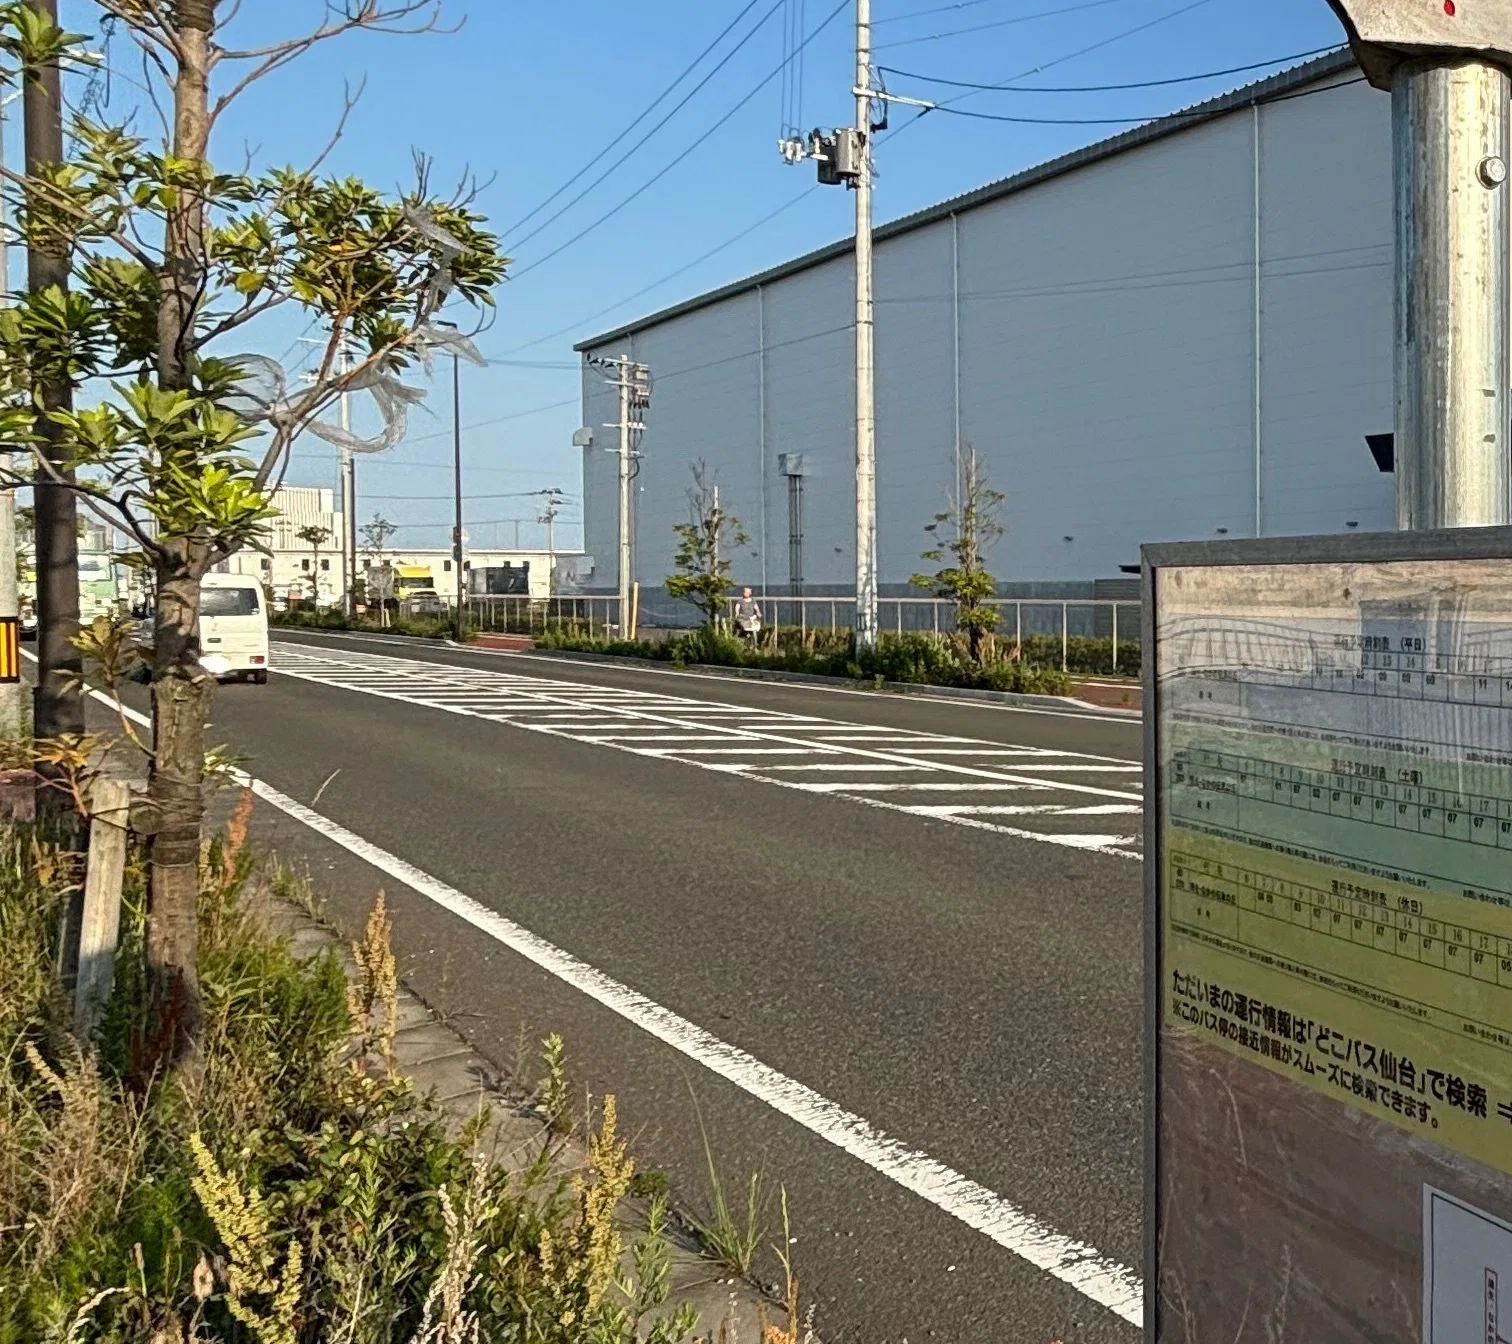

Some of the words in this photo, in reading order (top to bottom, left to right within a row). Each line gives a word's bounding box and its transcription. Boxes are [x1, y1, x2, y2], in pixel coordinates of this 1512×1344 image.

[1479, 800, 1489, 812] 17
[1448, 813, 1457, 824] 07
[1474, 817, 1484, 828] 07
[1502, 822, 1511, 833] 07
[1428, 922, 1437, 935] 15
[1453, 929, 1462, 942] 16
[1479, 936, 1489, 949] 17
